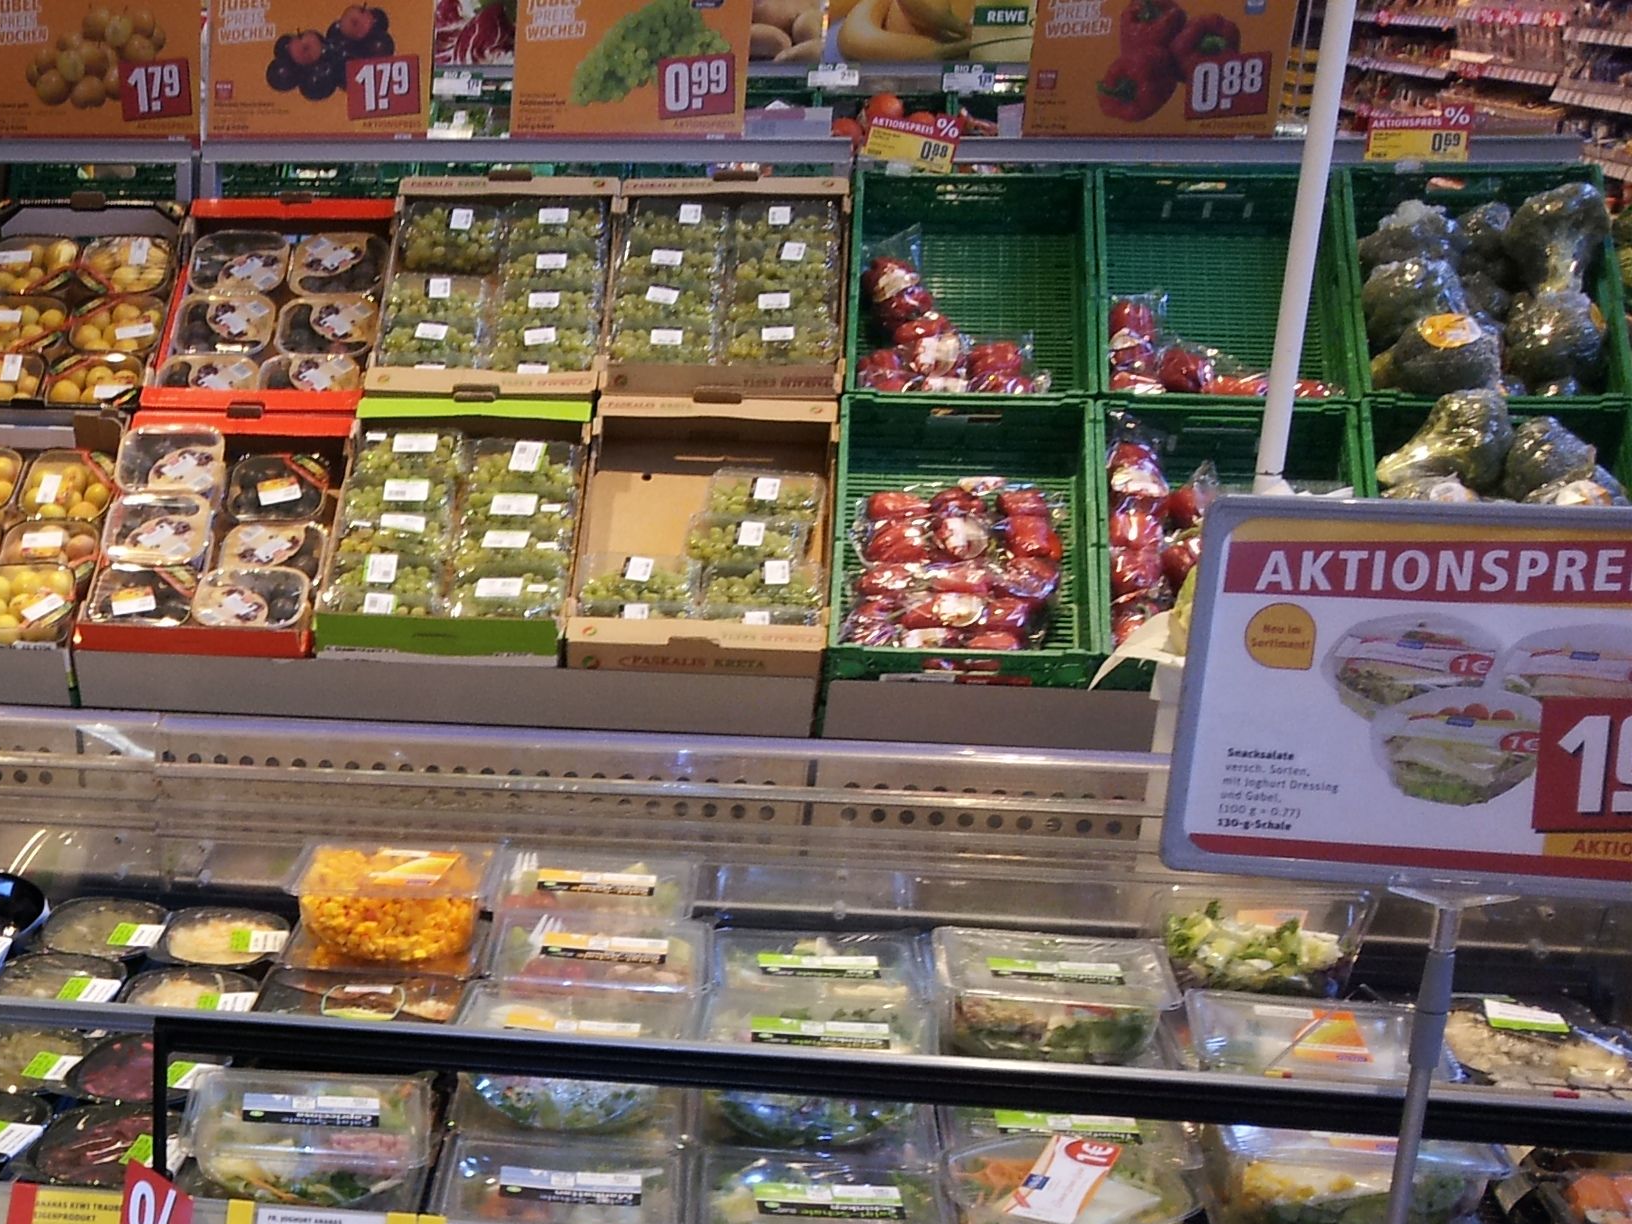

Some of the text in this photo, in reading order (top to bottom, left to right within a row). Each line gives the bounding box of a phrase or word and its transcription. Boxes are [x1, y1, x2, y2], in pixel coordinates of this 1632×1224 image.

[986, 11, 1026, 24] REWE
[219, 25, 275, 43] WOCHEN
[527, 22, 585, 41] WOCHEN
[1046, 18, 1112, 39] WOCHEN
[128, 64, 180, 113] 1.79
[356, 61, 409, 112] 1.79
[664, 59, 727, 112] 0.99
[1192, 59, 1263, 113] 0.88
[872, 116, 934, 135] AKTIONSPREIS
[1372, 116, 1442, 128] AKTIONSPREIS
[1255, 549, 1632, 592] AKTIONSPRE
[1227, 748, 1294, 761] Snacksalate
[1289, 781, 1339, 794] Dressing
